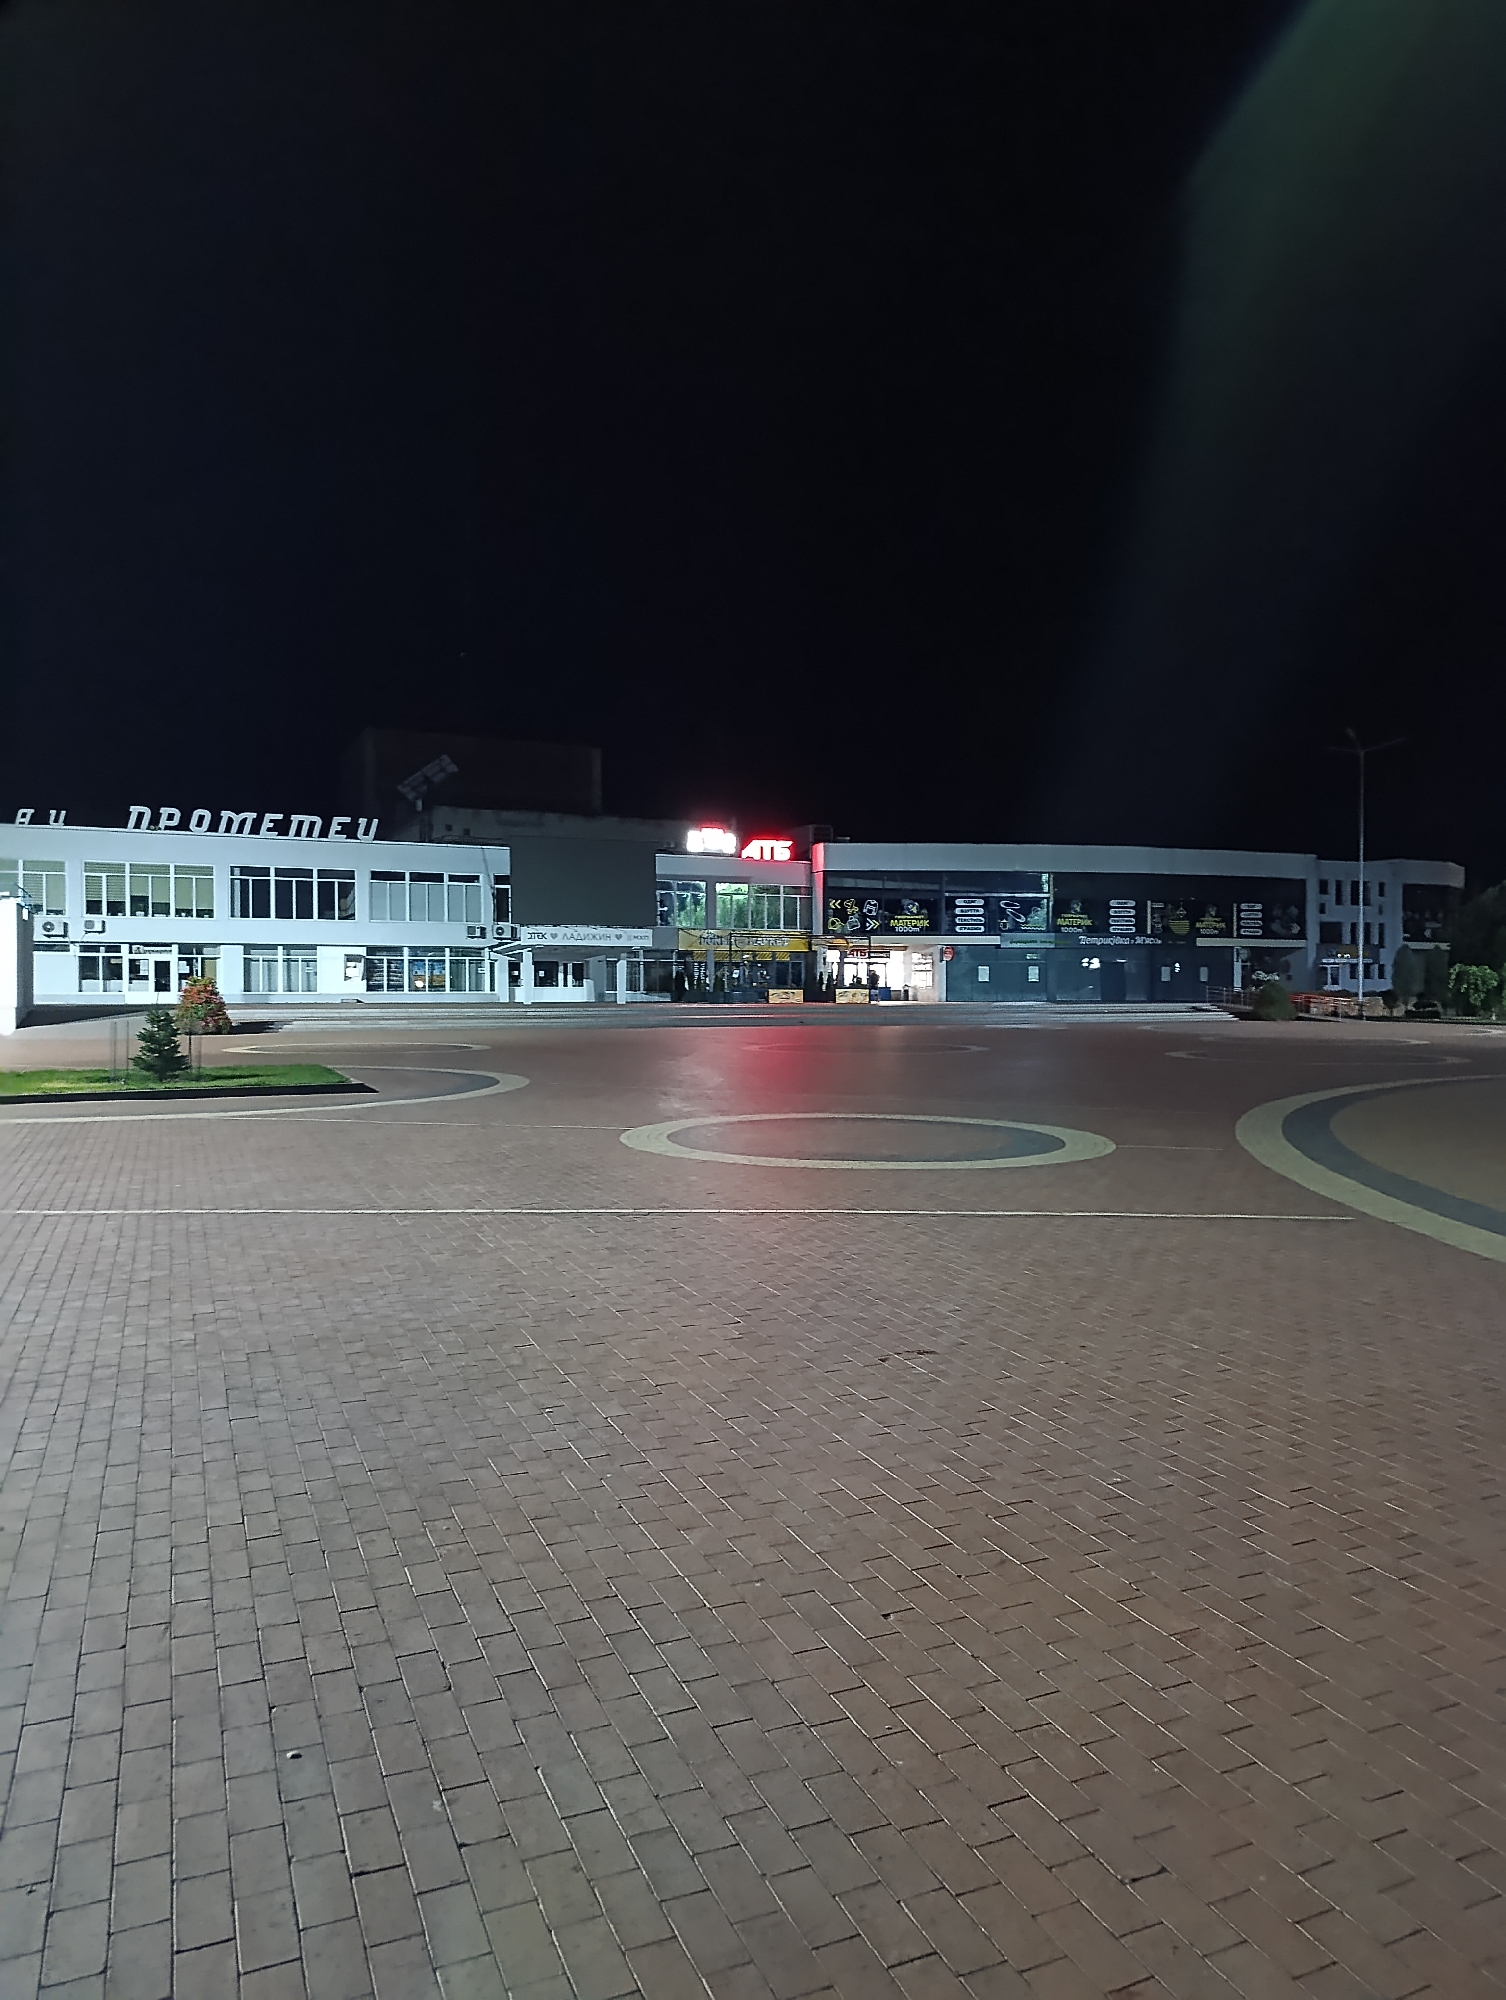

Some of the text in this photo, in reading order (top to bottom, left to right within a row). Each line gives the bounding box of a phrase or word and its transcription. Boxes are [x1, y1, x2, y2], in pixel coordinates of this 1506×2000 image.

[741, 839, 793, 861] АТБ
[889, 919, 930, 927] МАТЕРИК
[561, 932, 612, 941] ЛАДИЖИН
